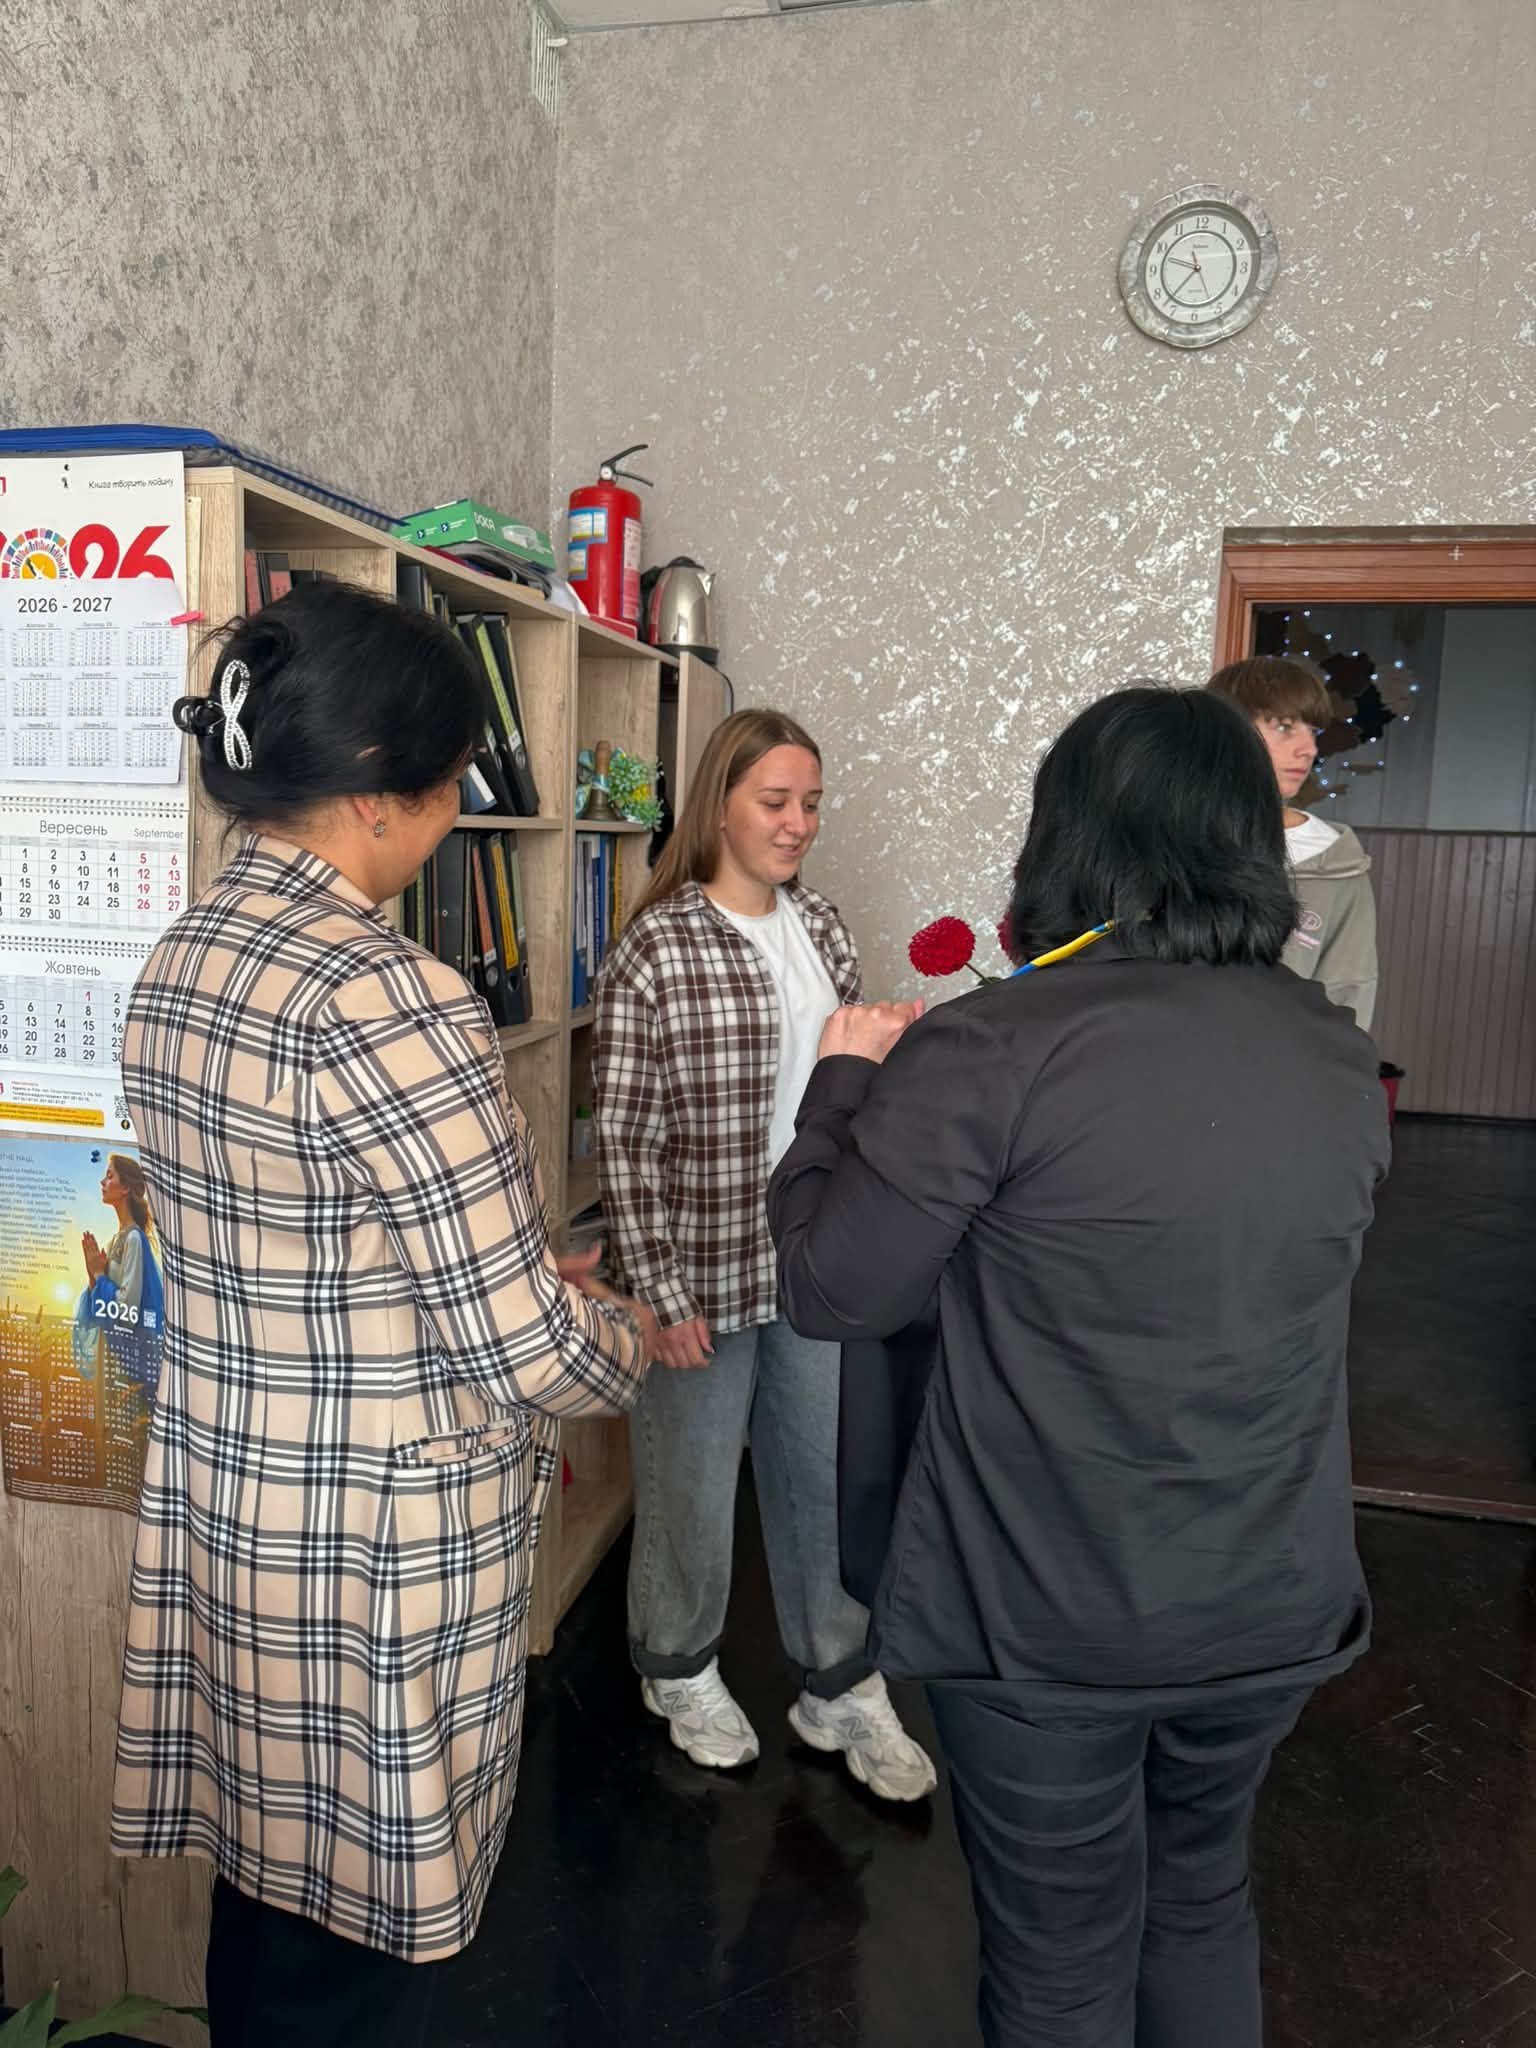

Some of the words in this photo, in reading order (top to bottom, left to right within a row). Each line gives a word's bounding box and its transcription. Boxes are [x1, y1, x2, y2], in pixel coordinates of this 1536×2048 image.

[1195, 216, 1209, 229] 12
[1175, 223, 1183, 236] 11
[1157, 241, 1168, 254] 10
[1236, 238, 1245, 250] 2
[1149, 265, 1157, 278] 9
[1239, 261, 1248, 274] 3
[1153, 288, 1161, 300] 8
[1231, 284, 1238, 296] 4
[1169, 305, 1177, 317] 7
[1214, 302, 1223, 314] 5
[1191, 310, 1198, 321] 6
[17, 598, 58, 613] 2026
[73, 597, 112, 613] 2027
[40, 820, 108, 837] Вересень
[134, 828, 184, 840] September
[22, 848, 27, 858] 1
[50, 849, 56, 859] 2
[80, 851, 86, 861] 3
[109, 852, 115, 862] 4
[140, 853, 146, 864] 5
[171, 855, 177, 865] 6
[21, 863, 27, 873] 8
[50, 864, 56, 874] 9
[78, 866, 89, 876] 10
[108, 867, 118, 877] 11
[138, 869, 150, 879] 12
[169, 870, 180, 881] 13
[20, 878, 30, 888] 15
[49, 879, 60, 889] 16
[78, 880, 89, 890] 17
[108, 882, 119, 892] 18
[138, 884, 150, 894] 19
[168, 885, 180, 896] 20
[20, 893, 31, 903] 22
[49, 894, 60, 904] 23
[78, 895, 89, 905] 24
[107, 897, 119, 907] 25
[138, 899, 150, 909] 26
[168, 901, 180, 911] 27
[20, 907, 31, 917] 29
[49, 909, 60, 919] 30
[45, 960, 101, 977] Жовтень
[85, 991, 90, 1001] 1
[114, 993, 120, 1003] 2
[27, 1002, 33, 1012] 6
[56, 1004, 62, 1014] 7
[85, 1006, 91, 1016] 8
[114, 1007, 120, 1017] 9
[26, 1016, 36, 1026] 13
[55, 1018, 65, 1028] 14
[83, 1021, 94, 1031] 15
[112, 1022, 123, 1033] 16
[25, 1031, 37, 1041] 20
[55, 1033, 65, 1043] 21
[83, 1035, 94, 1045] 22
[25, 1045, 37, 1055] 27
[55, 1047, 66, 1057] 28
[83, 1050, 95, 1060] 29
[95, 1299, 139, 1324] 2026
